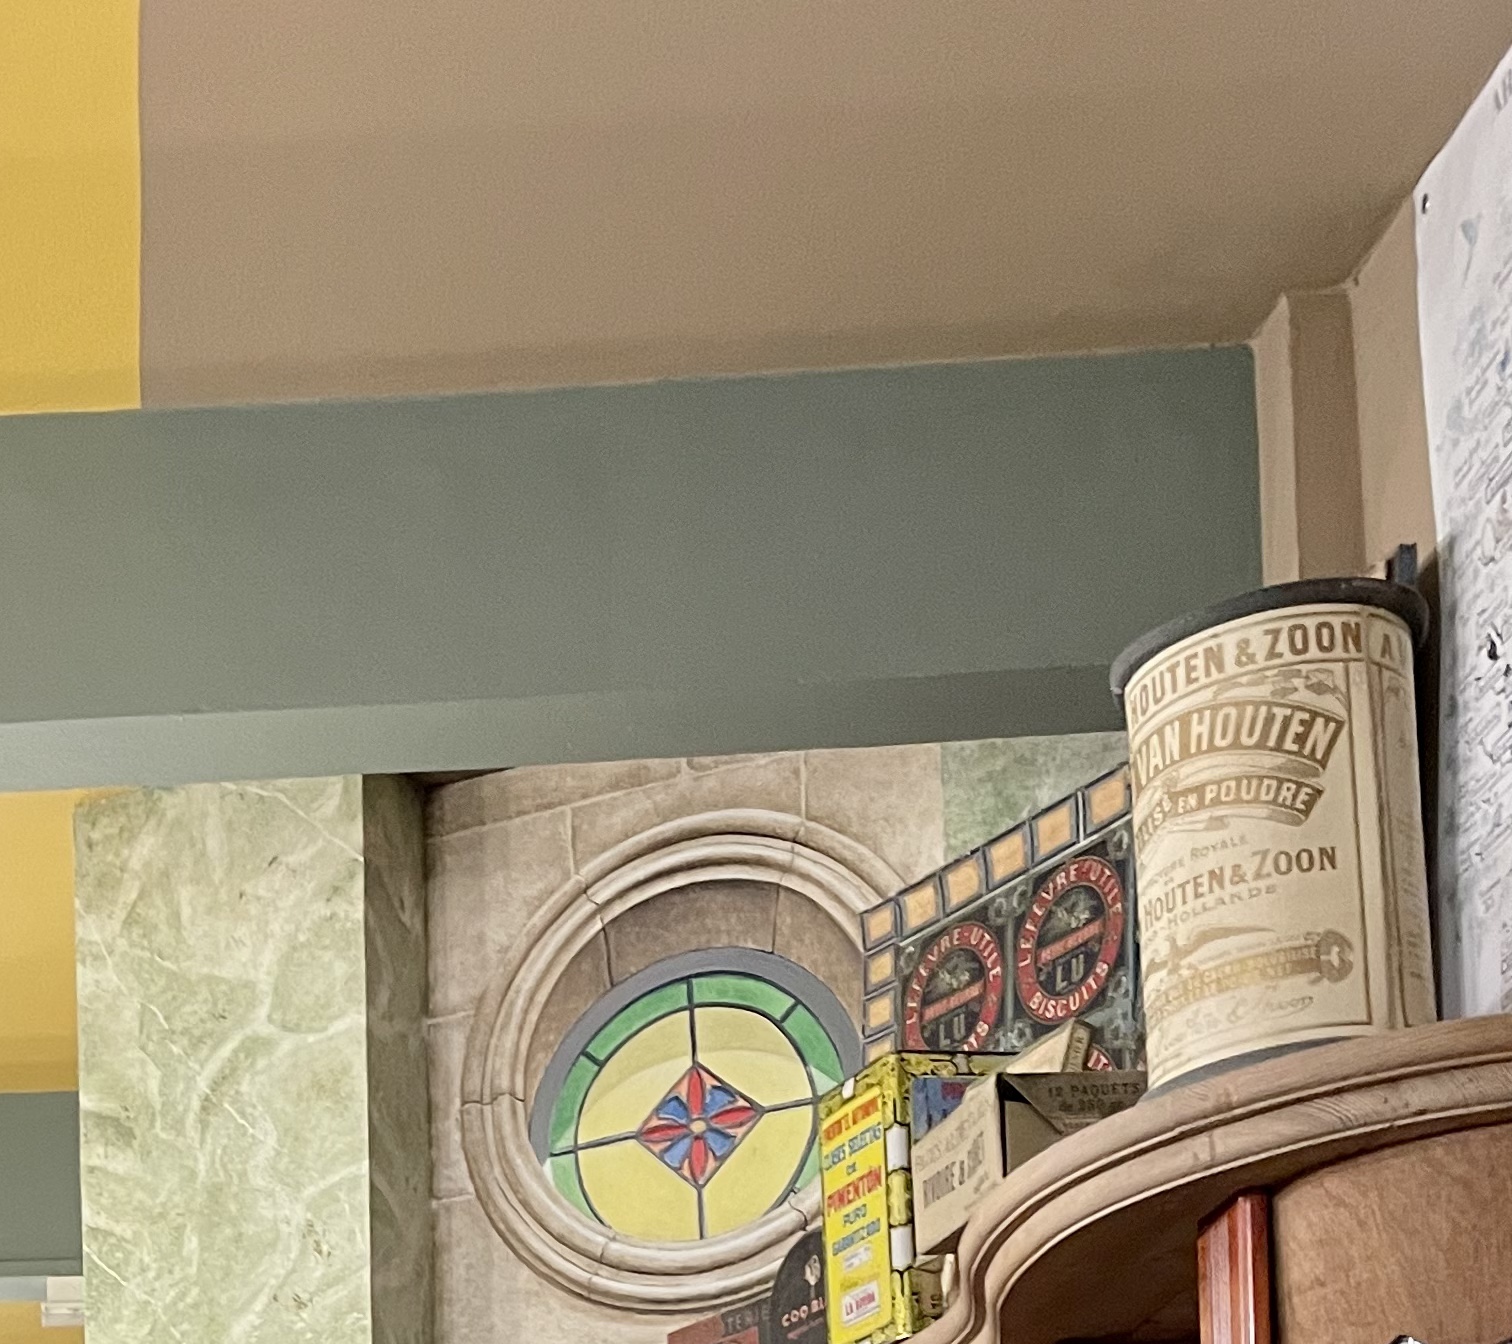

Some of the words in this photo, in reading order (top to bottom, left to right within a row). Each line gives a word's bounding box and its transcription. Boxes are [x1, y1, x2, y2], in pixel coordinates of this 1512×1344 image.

[1234, 637, 1258, 667] &
[1263, 621, 1362, 662] ZOON
[1137, 717, 1180, 787] VAN
[1190, 704, 1337, 759] HOUTEN
[1204, 777, 1317, 812] POUDRE
[1143, 865, 1225, 922] HOUTEN
[1229, 864, 1248, 886] &
[1251, 846, 1337, 882] ZOON
[1029, 961, 1110, 1020] BISCUITS
[1055, 953, 1085, 992] LU
[939, 1013, 966, 1050] LU
[1070, 1082, 1141, 1099] PAQUETS
